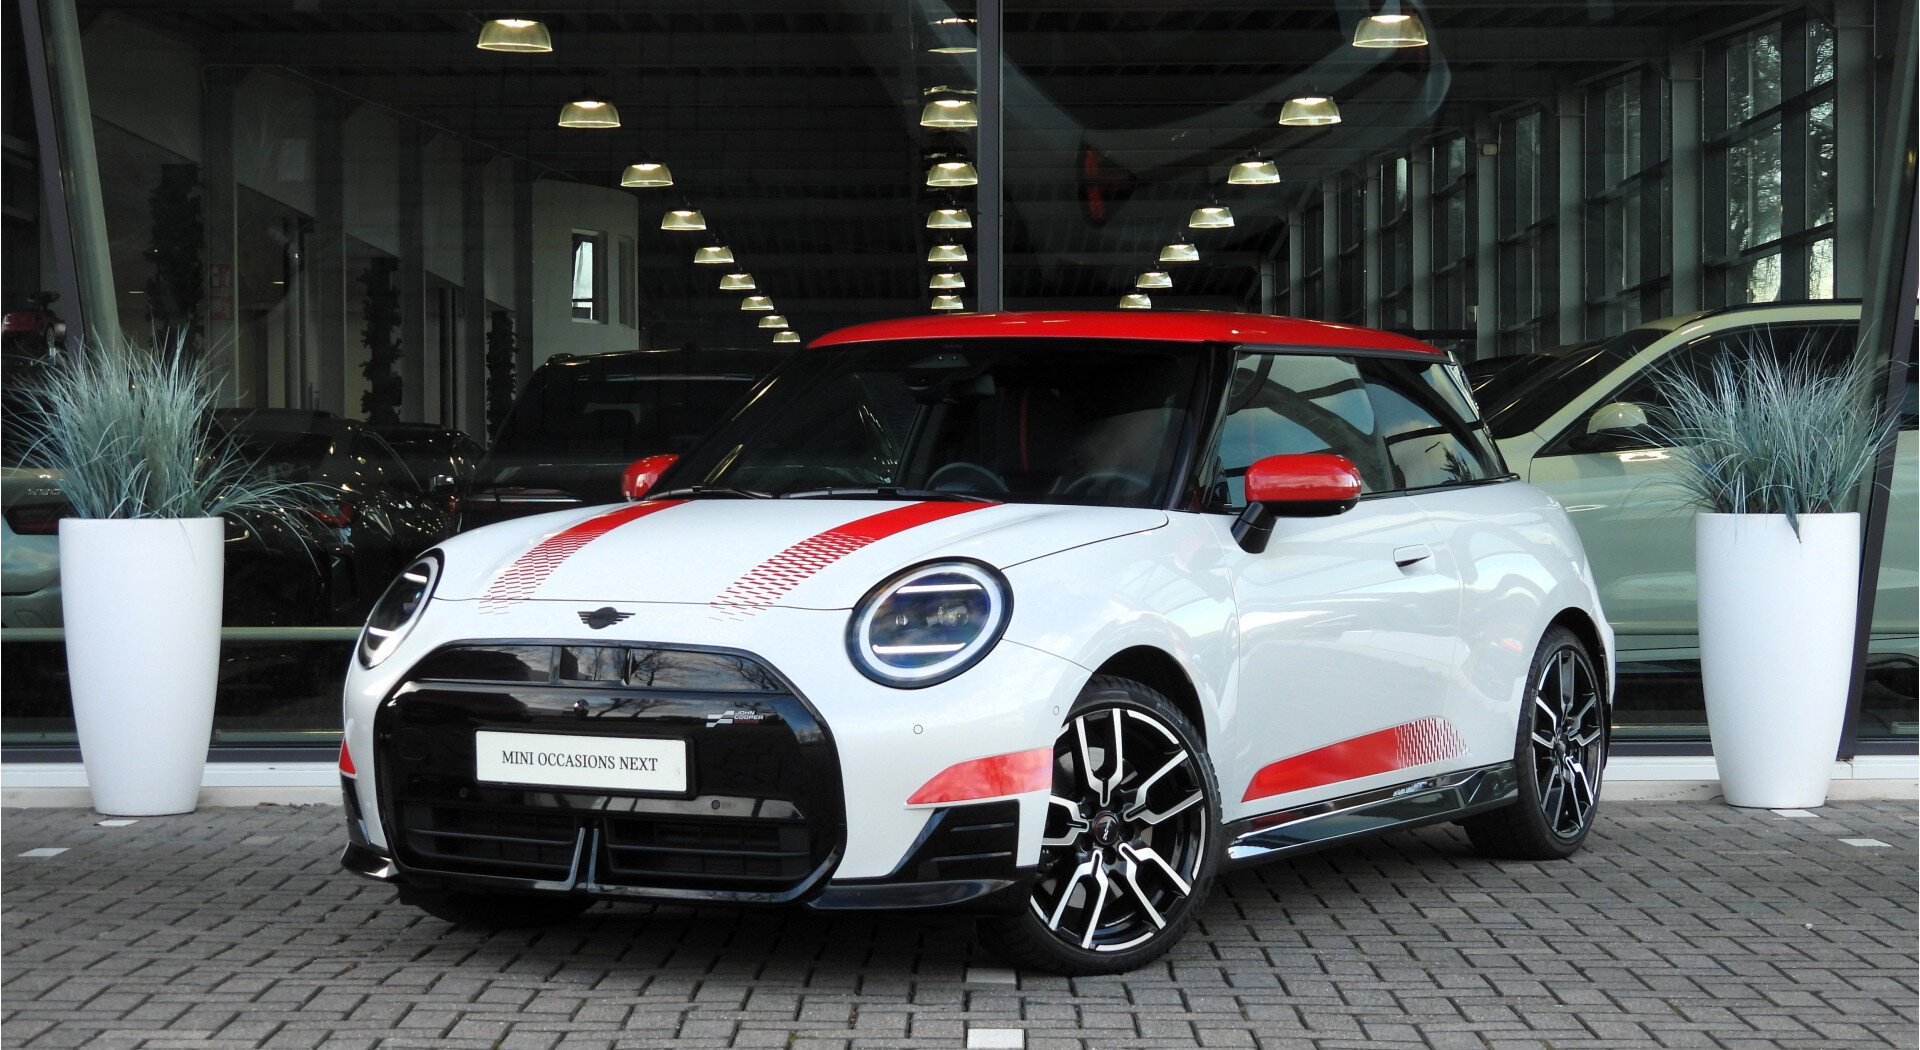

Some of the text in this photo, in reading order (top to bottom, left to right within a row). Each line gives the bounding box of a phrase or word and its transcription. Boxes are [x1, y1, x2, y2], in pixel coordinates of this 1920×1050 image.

[502, 750, 659, 772] MINI OCCASIONS NEXT
